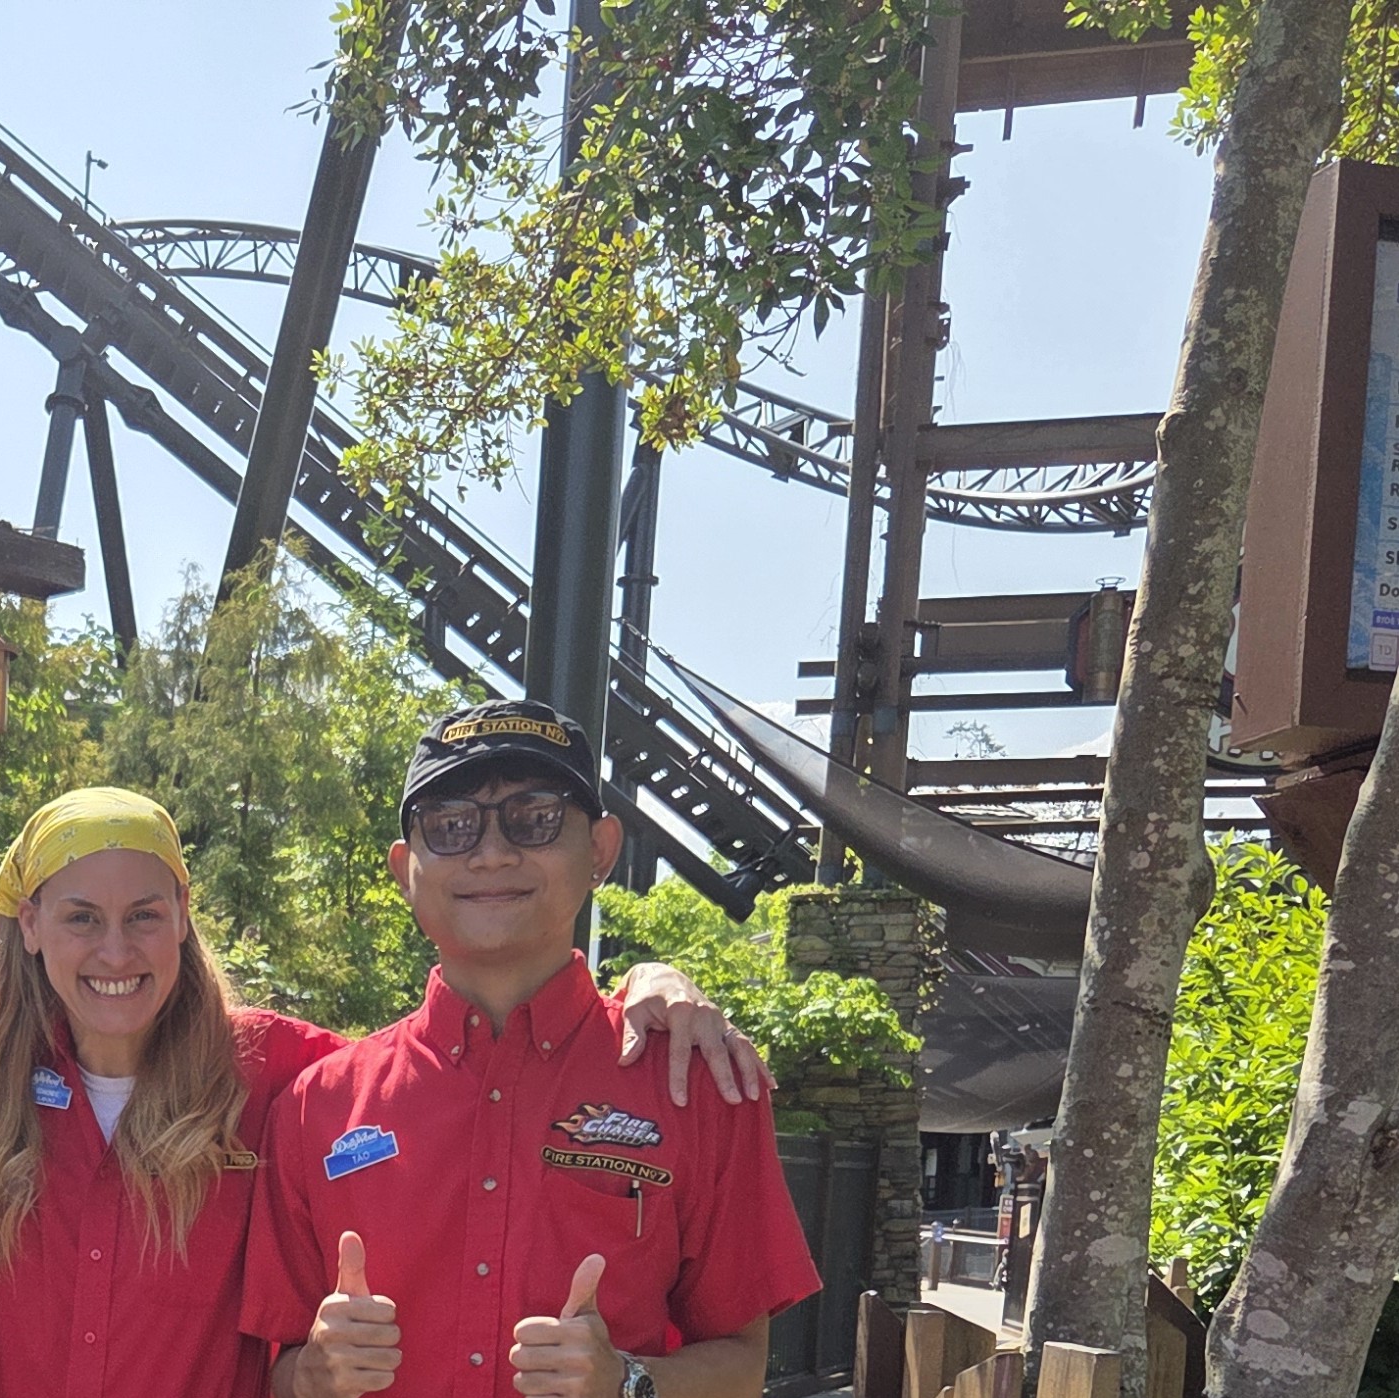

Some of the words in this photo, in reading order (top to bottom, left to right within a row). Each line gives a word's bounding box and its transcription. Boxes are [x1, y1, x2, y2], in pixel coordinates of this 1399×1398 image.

[482, 721, 542, 733] STATION
[544, 1150, 572, 1164] FIRE
[575, 1156, 637, 1174] STATION
